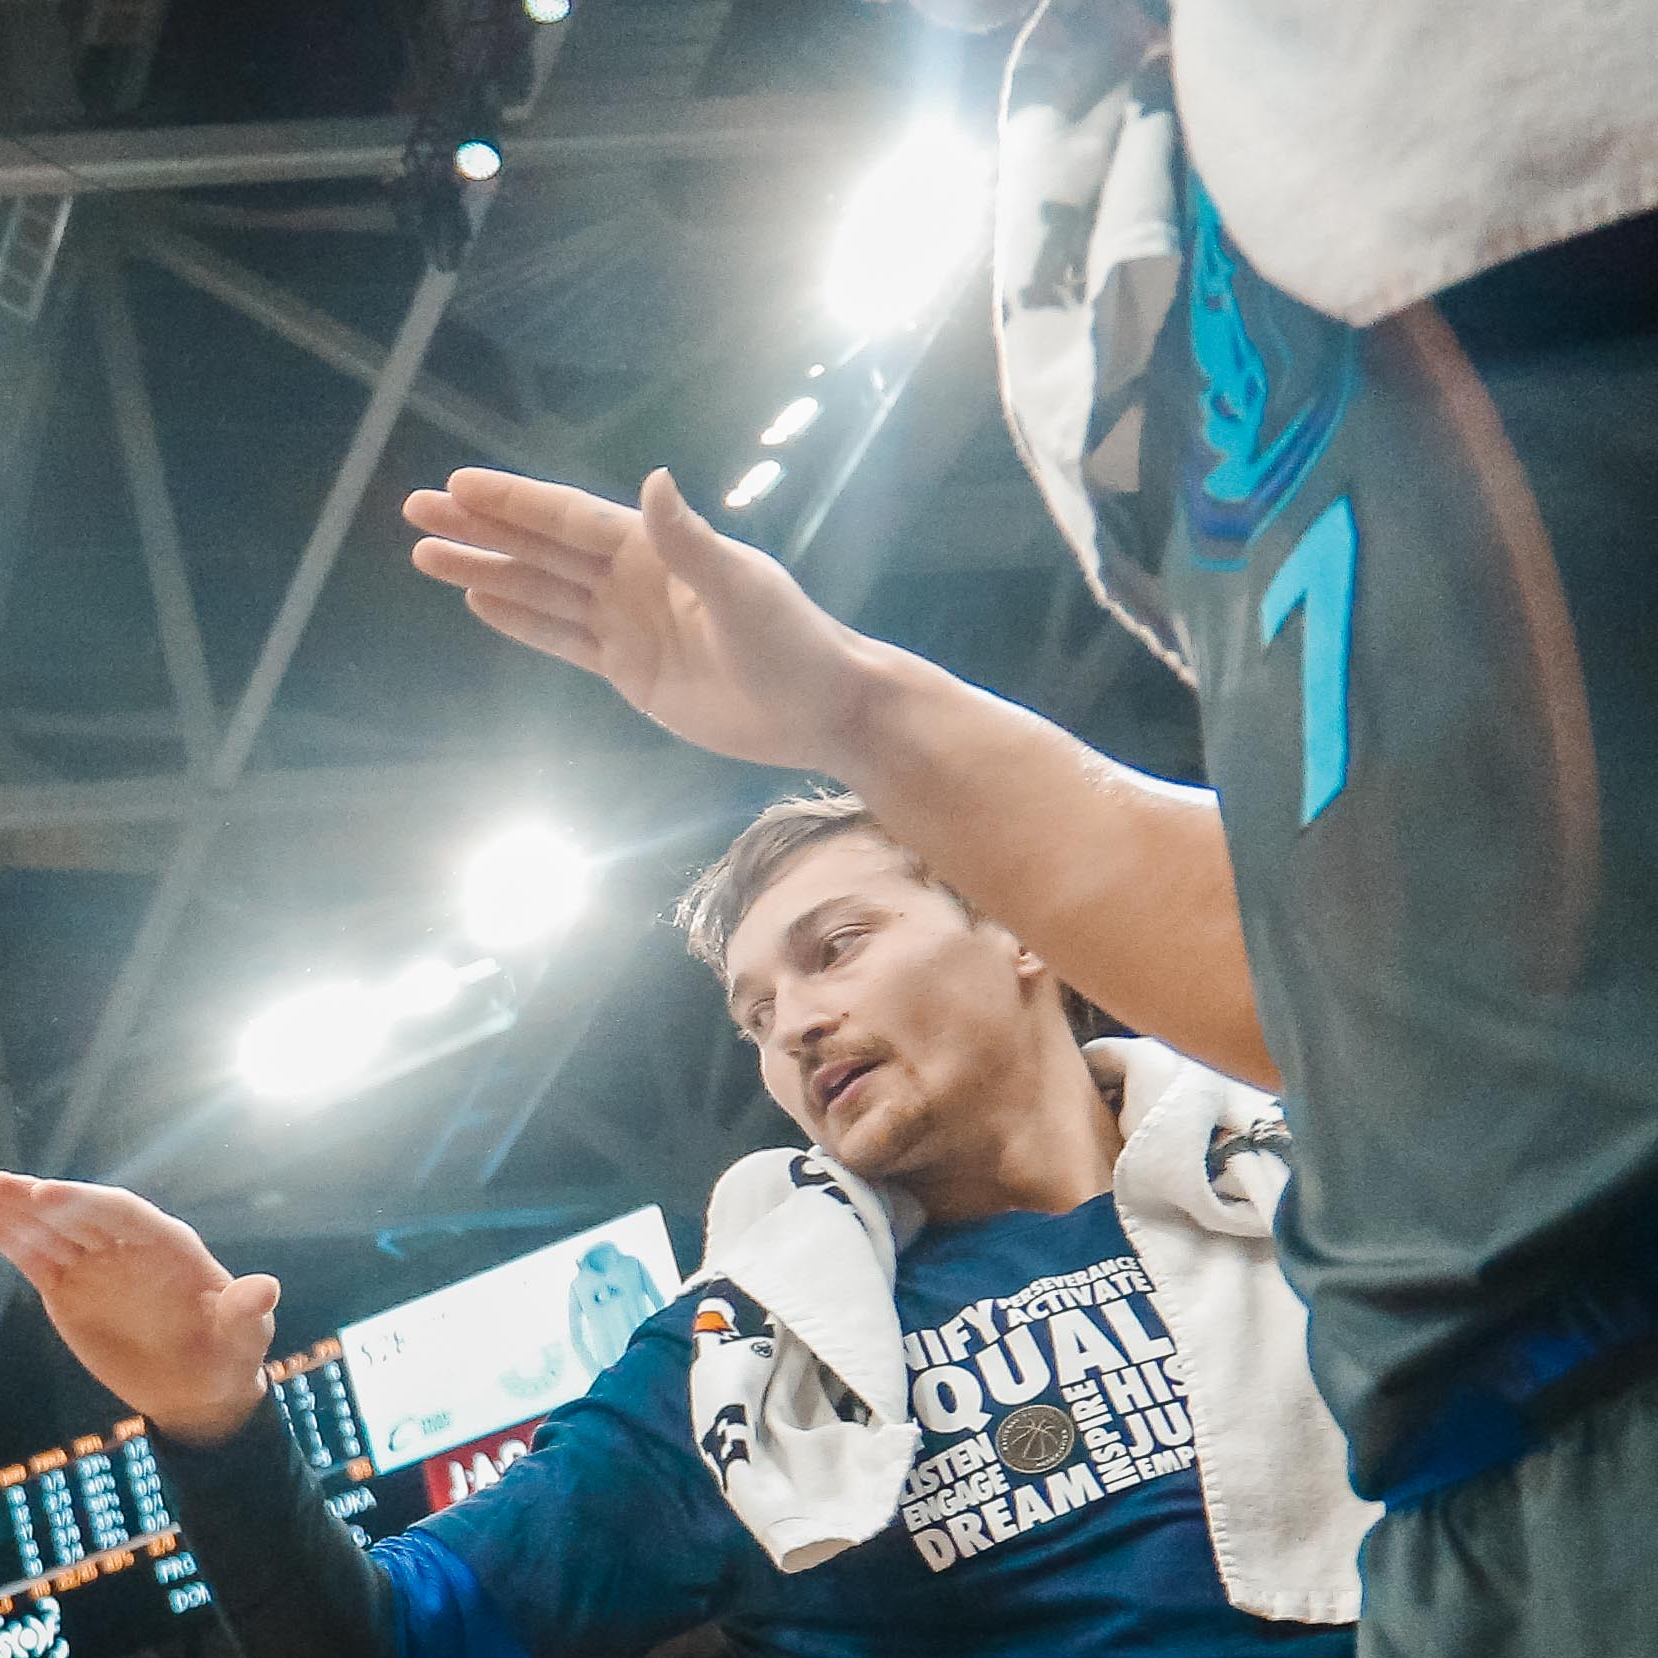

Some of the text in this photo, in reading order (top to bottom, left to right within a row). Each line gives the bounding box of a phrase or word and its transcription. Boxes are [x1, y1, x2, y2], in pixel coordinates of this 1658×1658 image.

[998, 1256, 1143, 1310] PERSEVERANCE
[1010, 1270, 1153, 1326] ACTIVATE
[1061, 1380, 1138, 1492] INSPIRE
[903, 1463, 1011, 1535] ENGAGE
[911, 1463, 1104, 1572] DREAM
